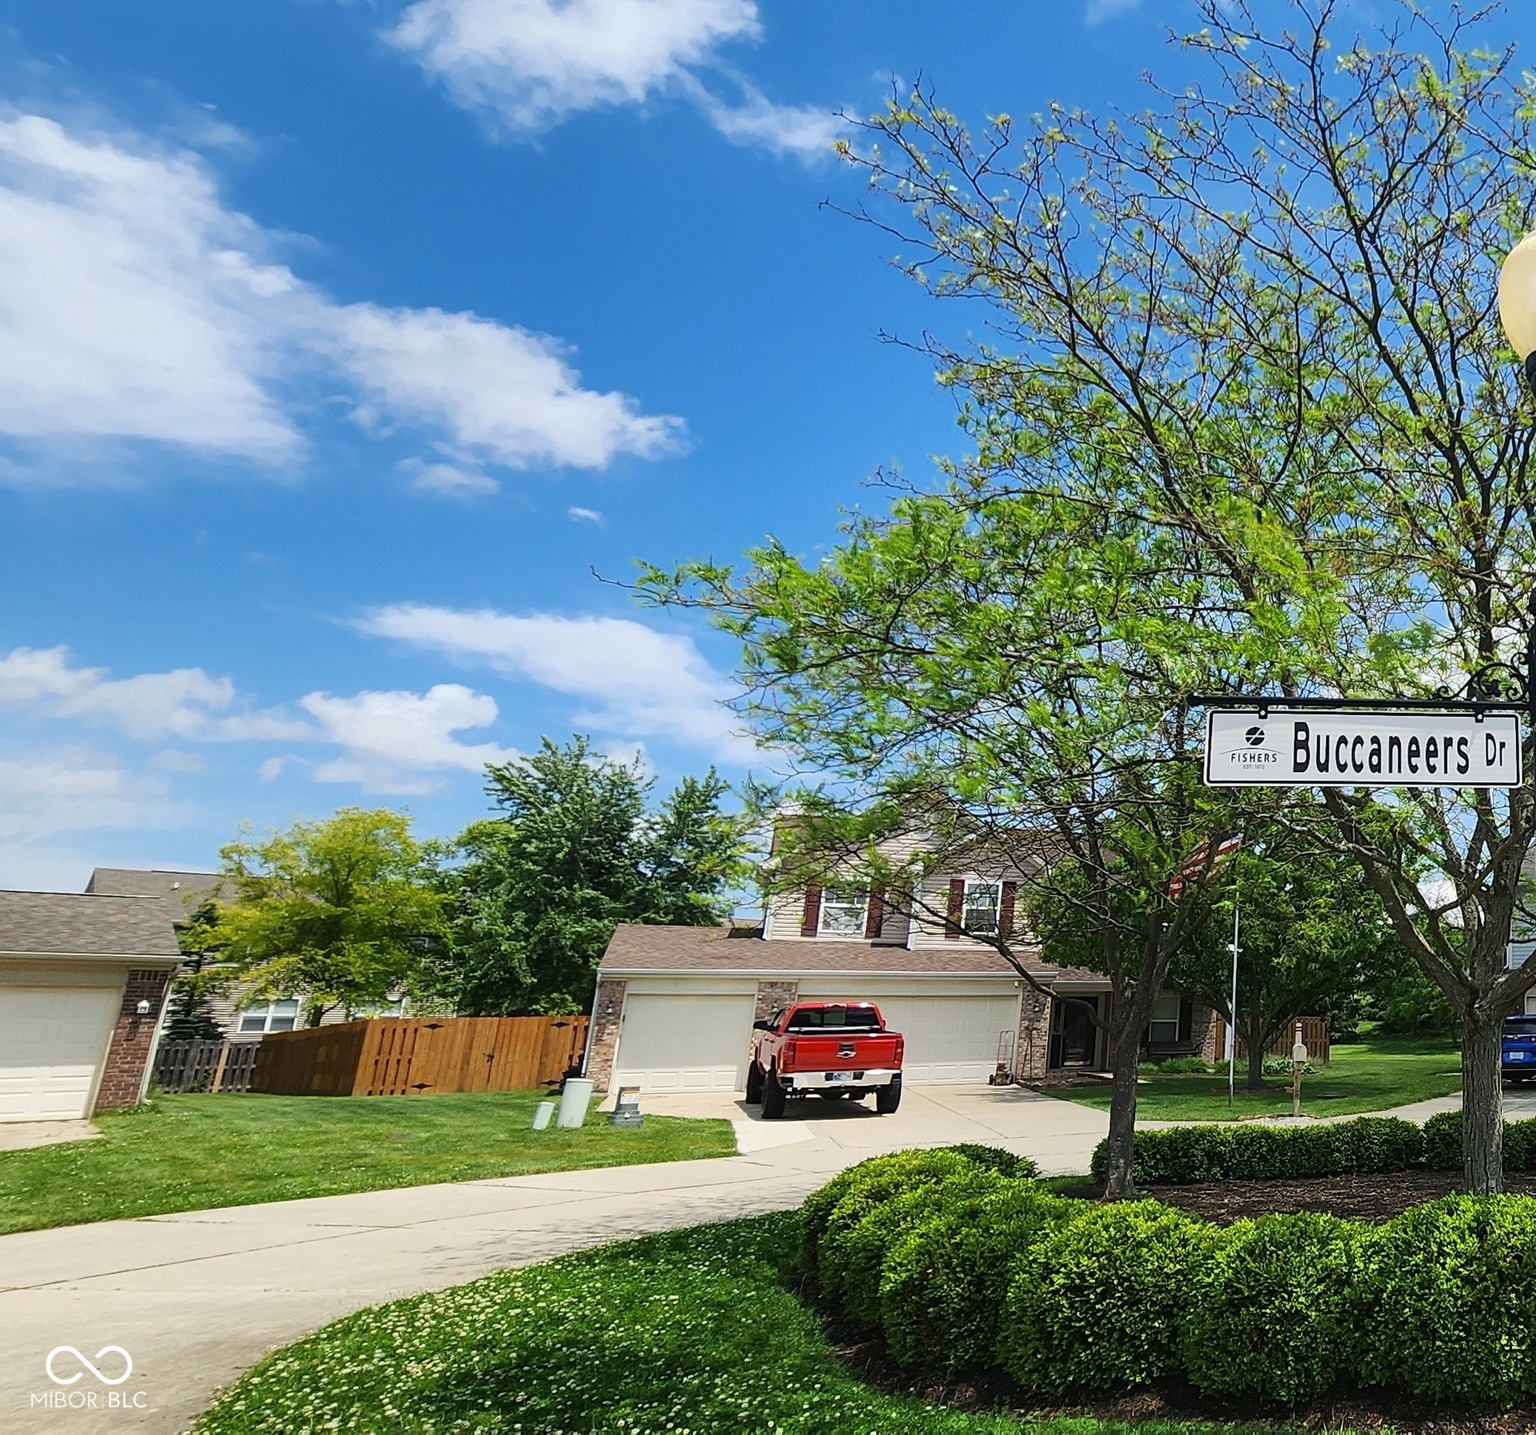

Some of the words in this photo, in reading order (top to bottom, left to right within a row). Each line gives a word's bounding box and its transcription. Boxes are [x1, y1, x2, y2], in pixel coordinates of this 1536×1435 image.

[1230, 752, 1278, 763] FISHERS
[1292, 721, 1470, 775] Buccaneers
[1485, 732, 1507, 767] Dr
